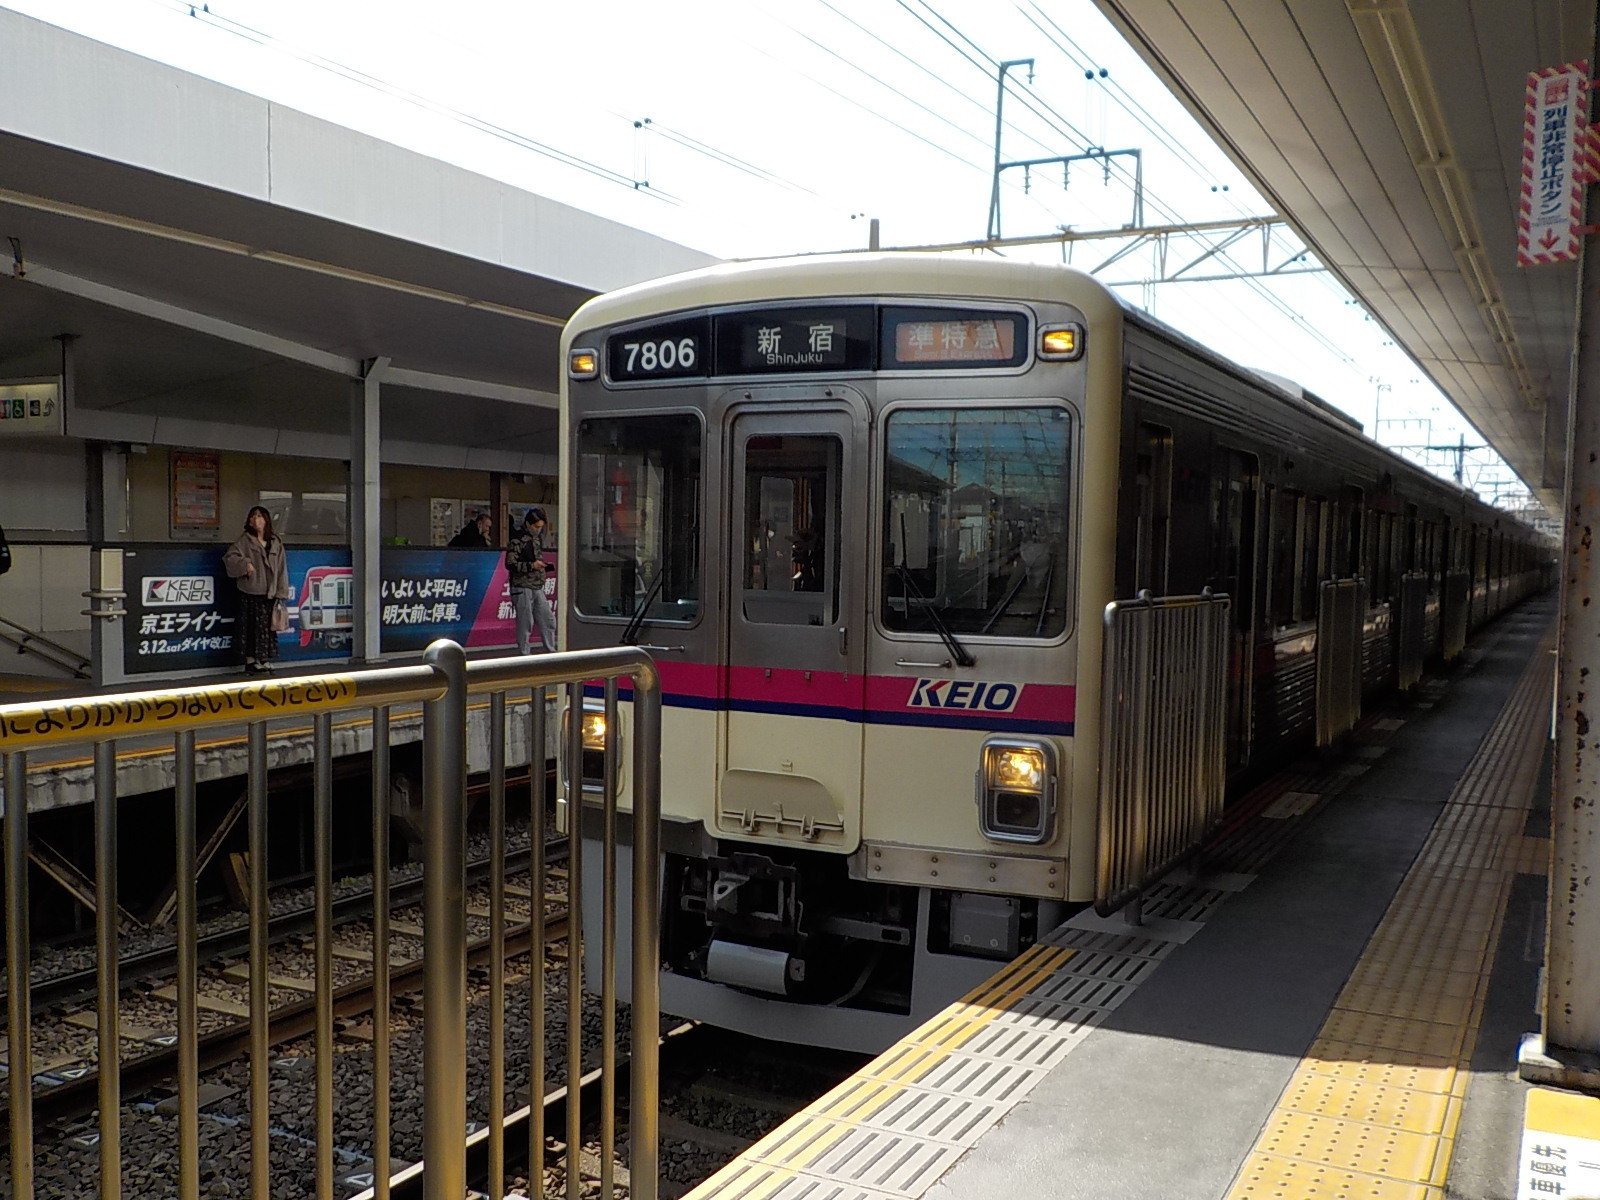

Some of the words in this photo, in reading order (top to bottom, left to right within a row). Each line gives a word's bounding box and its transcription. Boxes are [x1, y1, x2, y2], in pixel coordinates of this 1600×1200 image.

[1540, 105, 1568, 215] 列車非常停止ボタン
[757, 323, 834, 355] 新宿
[908, 320, 999, 350] 準特急
[623, 337, 696, 373] 7806
[164, 589, 212, 603] LINER
[166, 578, 206, 591] KEIO
[138, 611, 235, 635] 京王ライナー
[910, 678, 1018, 711] KEIO
[1528, 1144, 1567, 1200] 車優先
